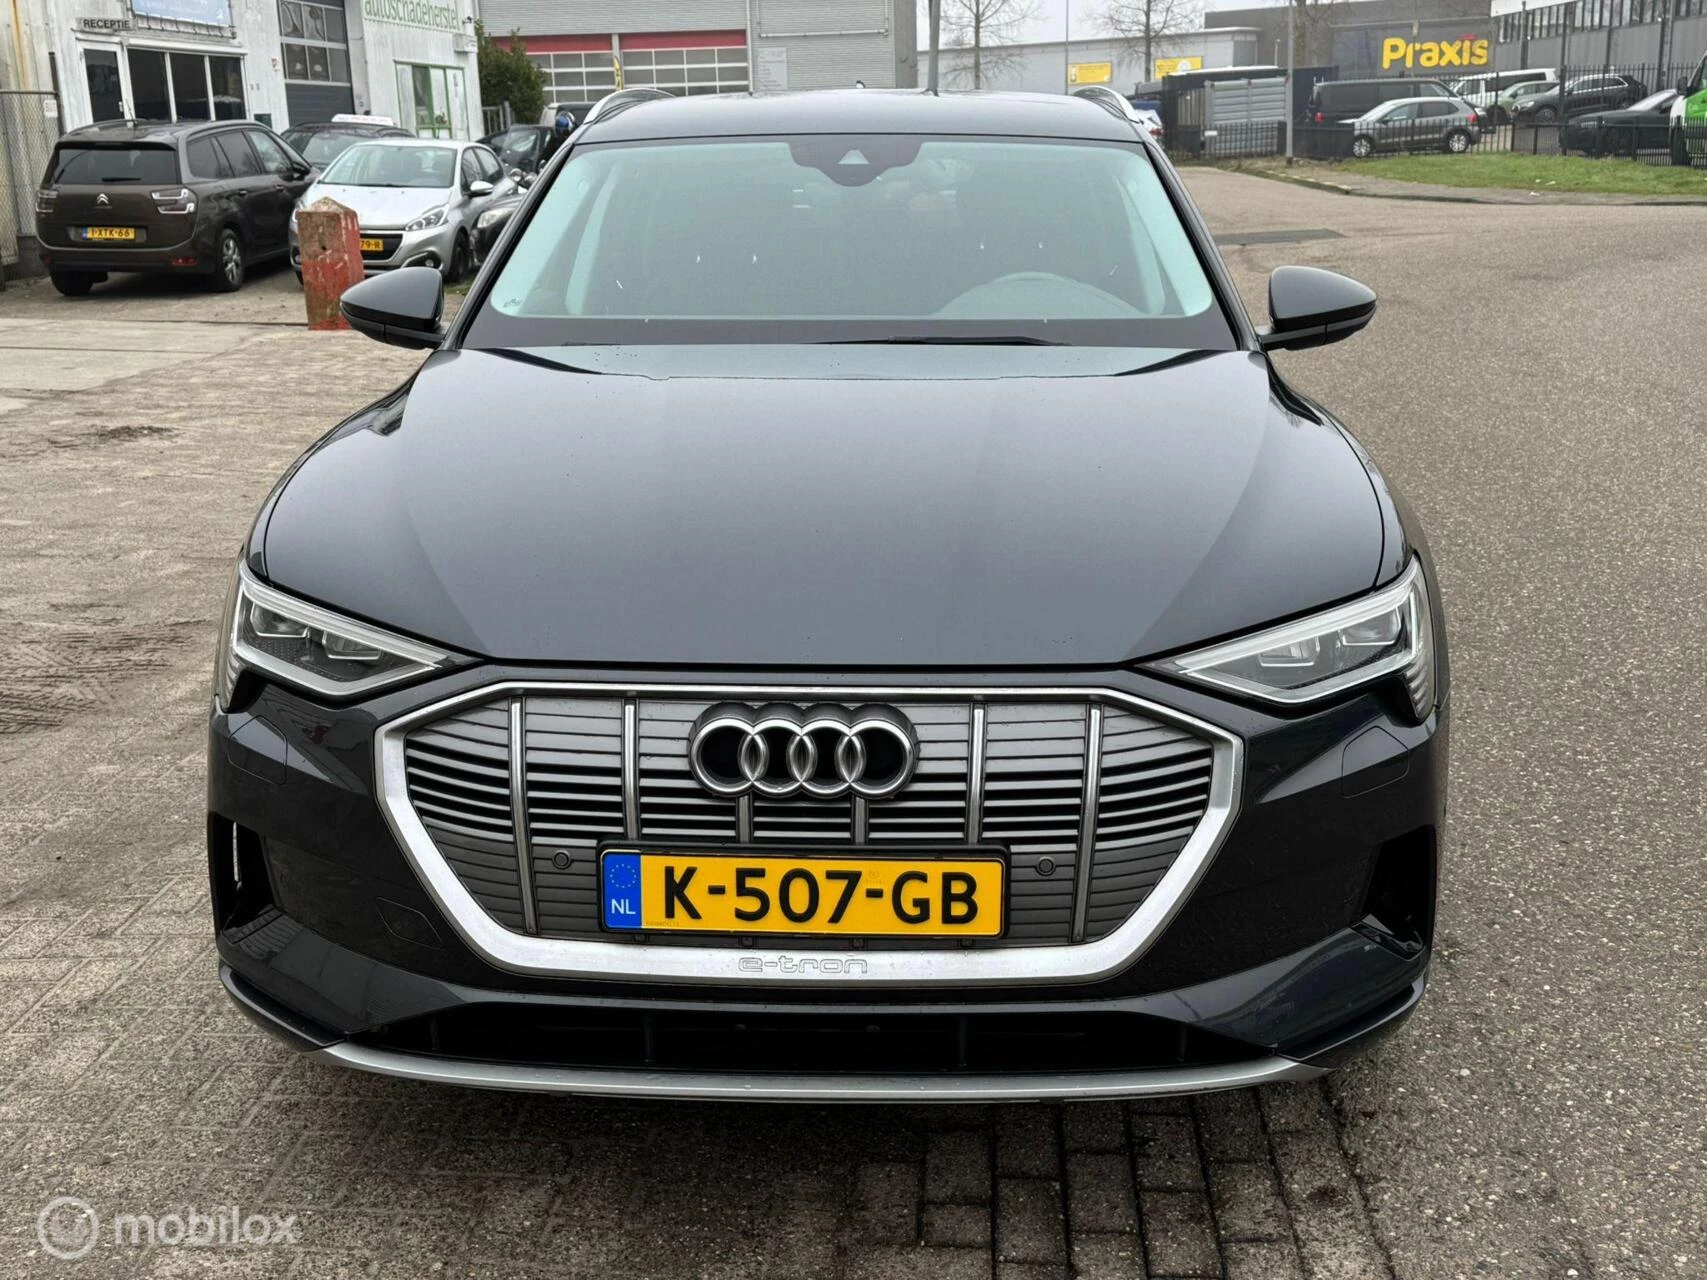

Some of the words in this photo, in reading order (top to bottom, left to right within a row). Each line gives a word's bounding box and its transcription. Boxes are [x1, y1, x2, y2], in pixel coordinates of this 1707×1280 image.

[83, 19, 131, 30] RECEPTIE
[1382, 37, 1489, 70] Praxis
[90, 227, 131, 238] 1-XTK-66
[664, 865, 979, 926] K-507-GB
[611, 898, 636, 915] NL
[738, 955, 868, 975] e-tron
